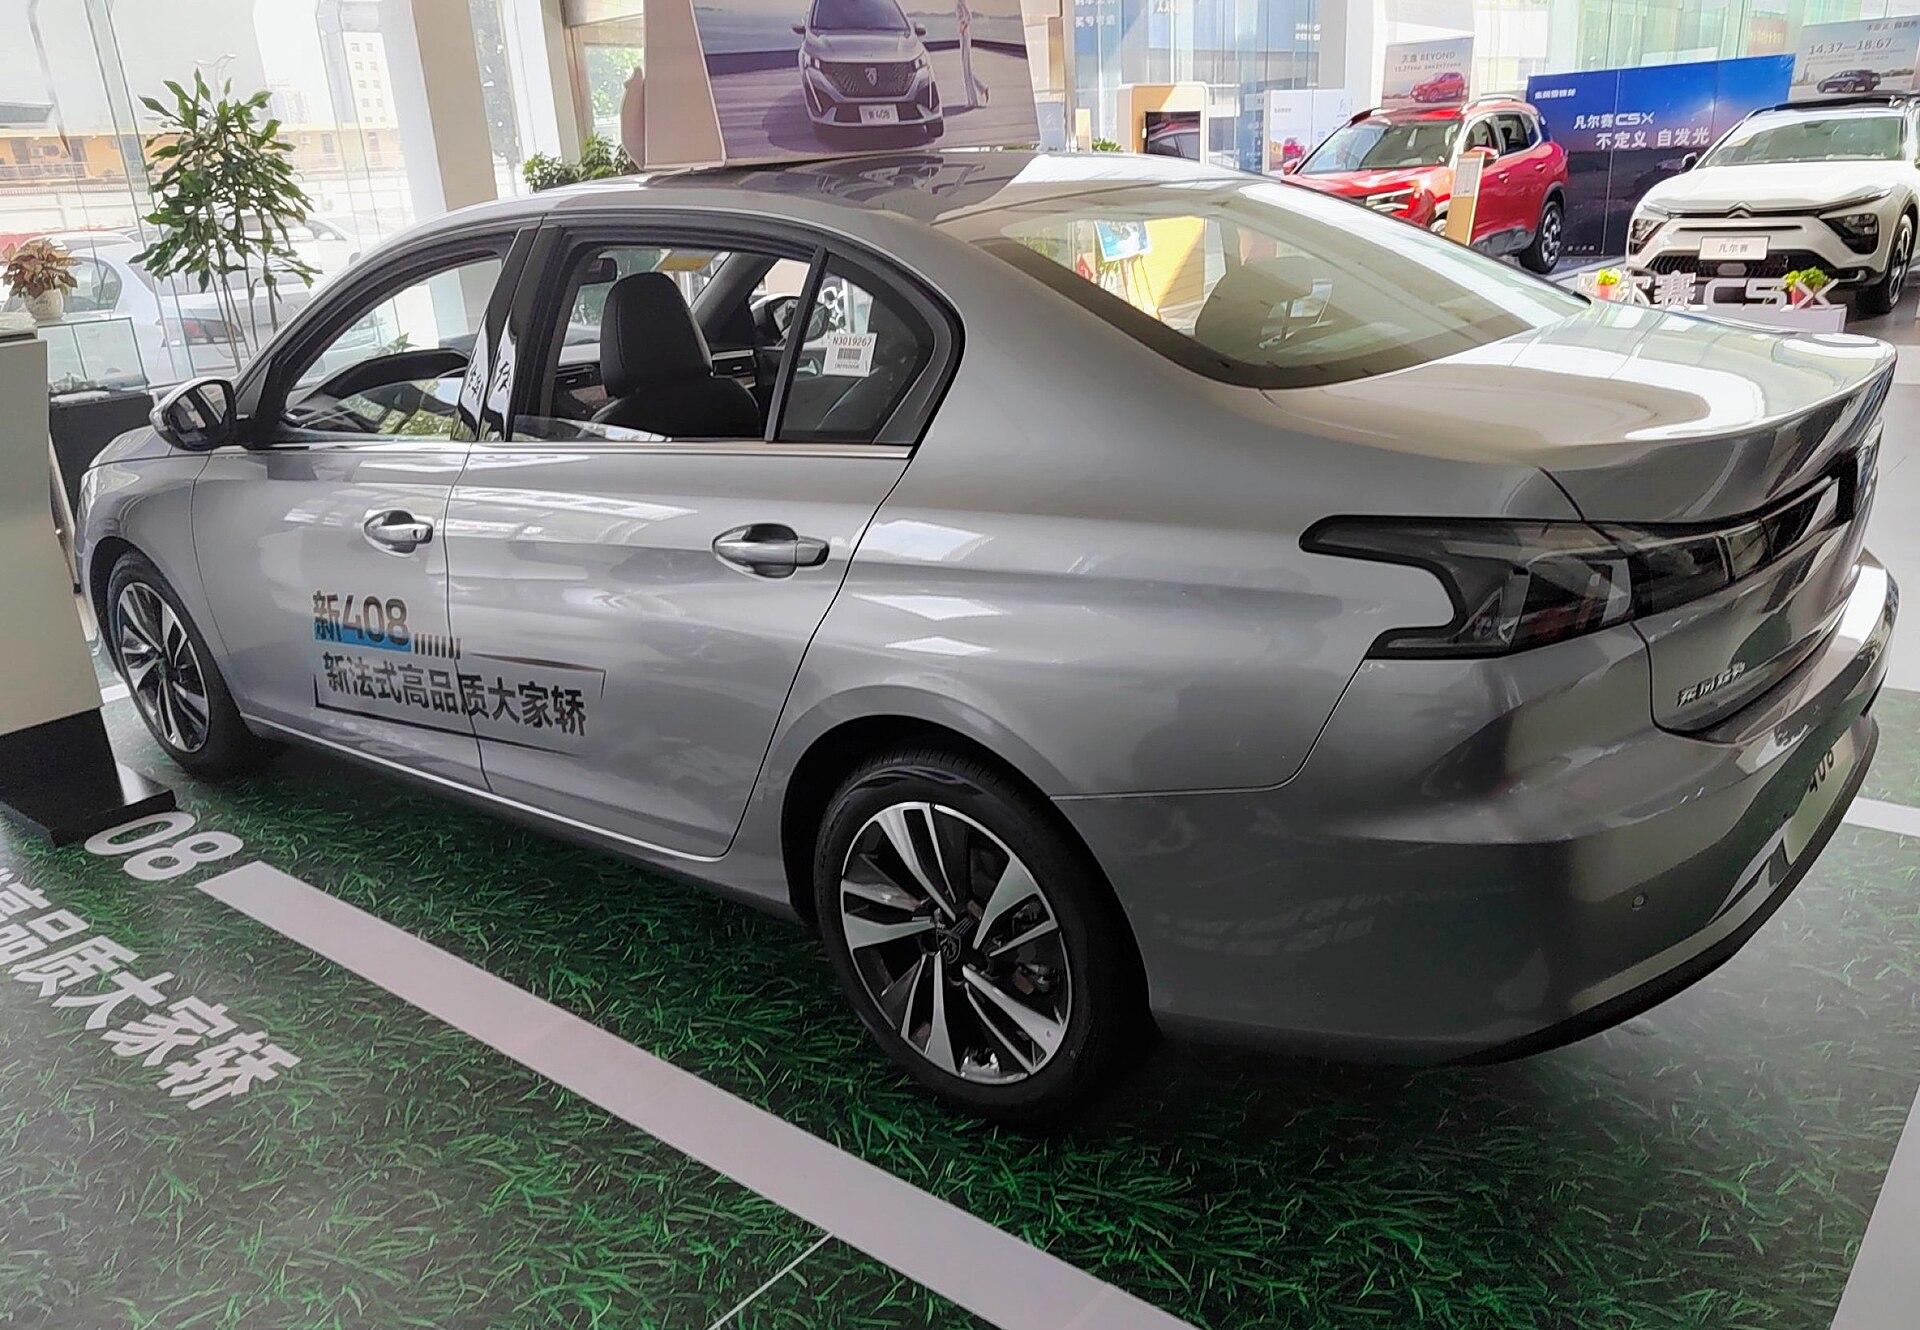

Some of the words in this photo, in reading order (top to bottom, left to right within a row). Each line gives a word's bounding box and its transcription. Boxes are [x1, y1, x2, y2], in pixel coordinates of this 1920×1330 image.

[1595, 130, 1647, 150] 不定义
[1657, 127, 1711, 147] 自发光
[312, 590, 409, 646] 新408
[323, 651, 587, 736] 新法式高品质大家轿
